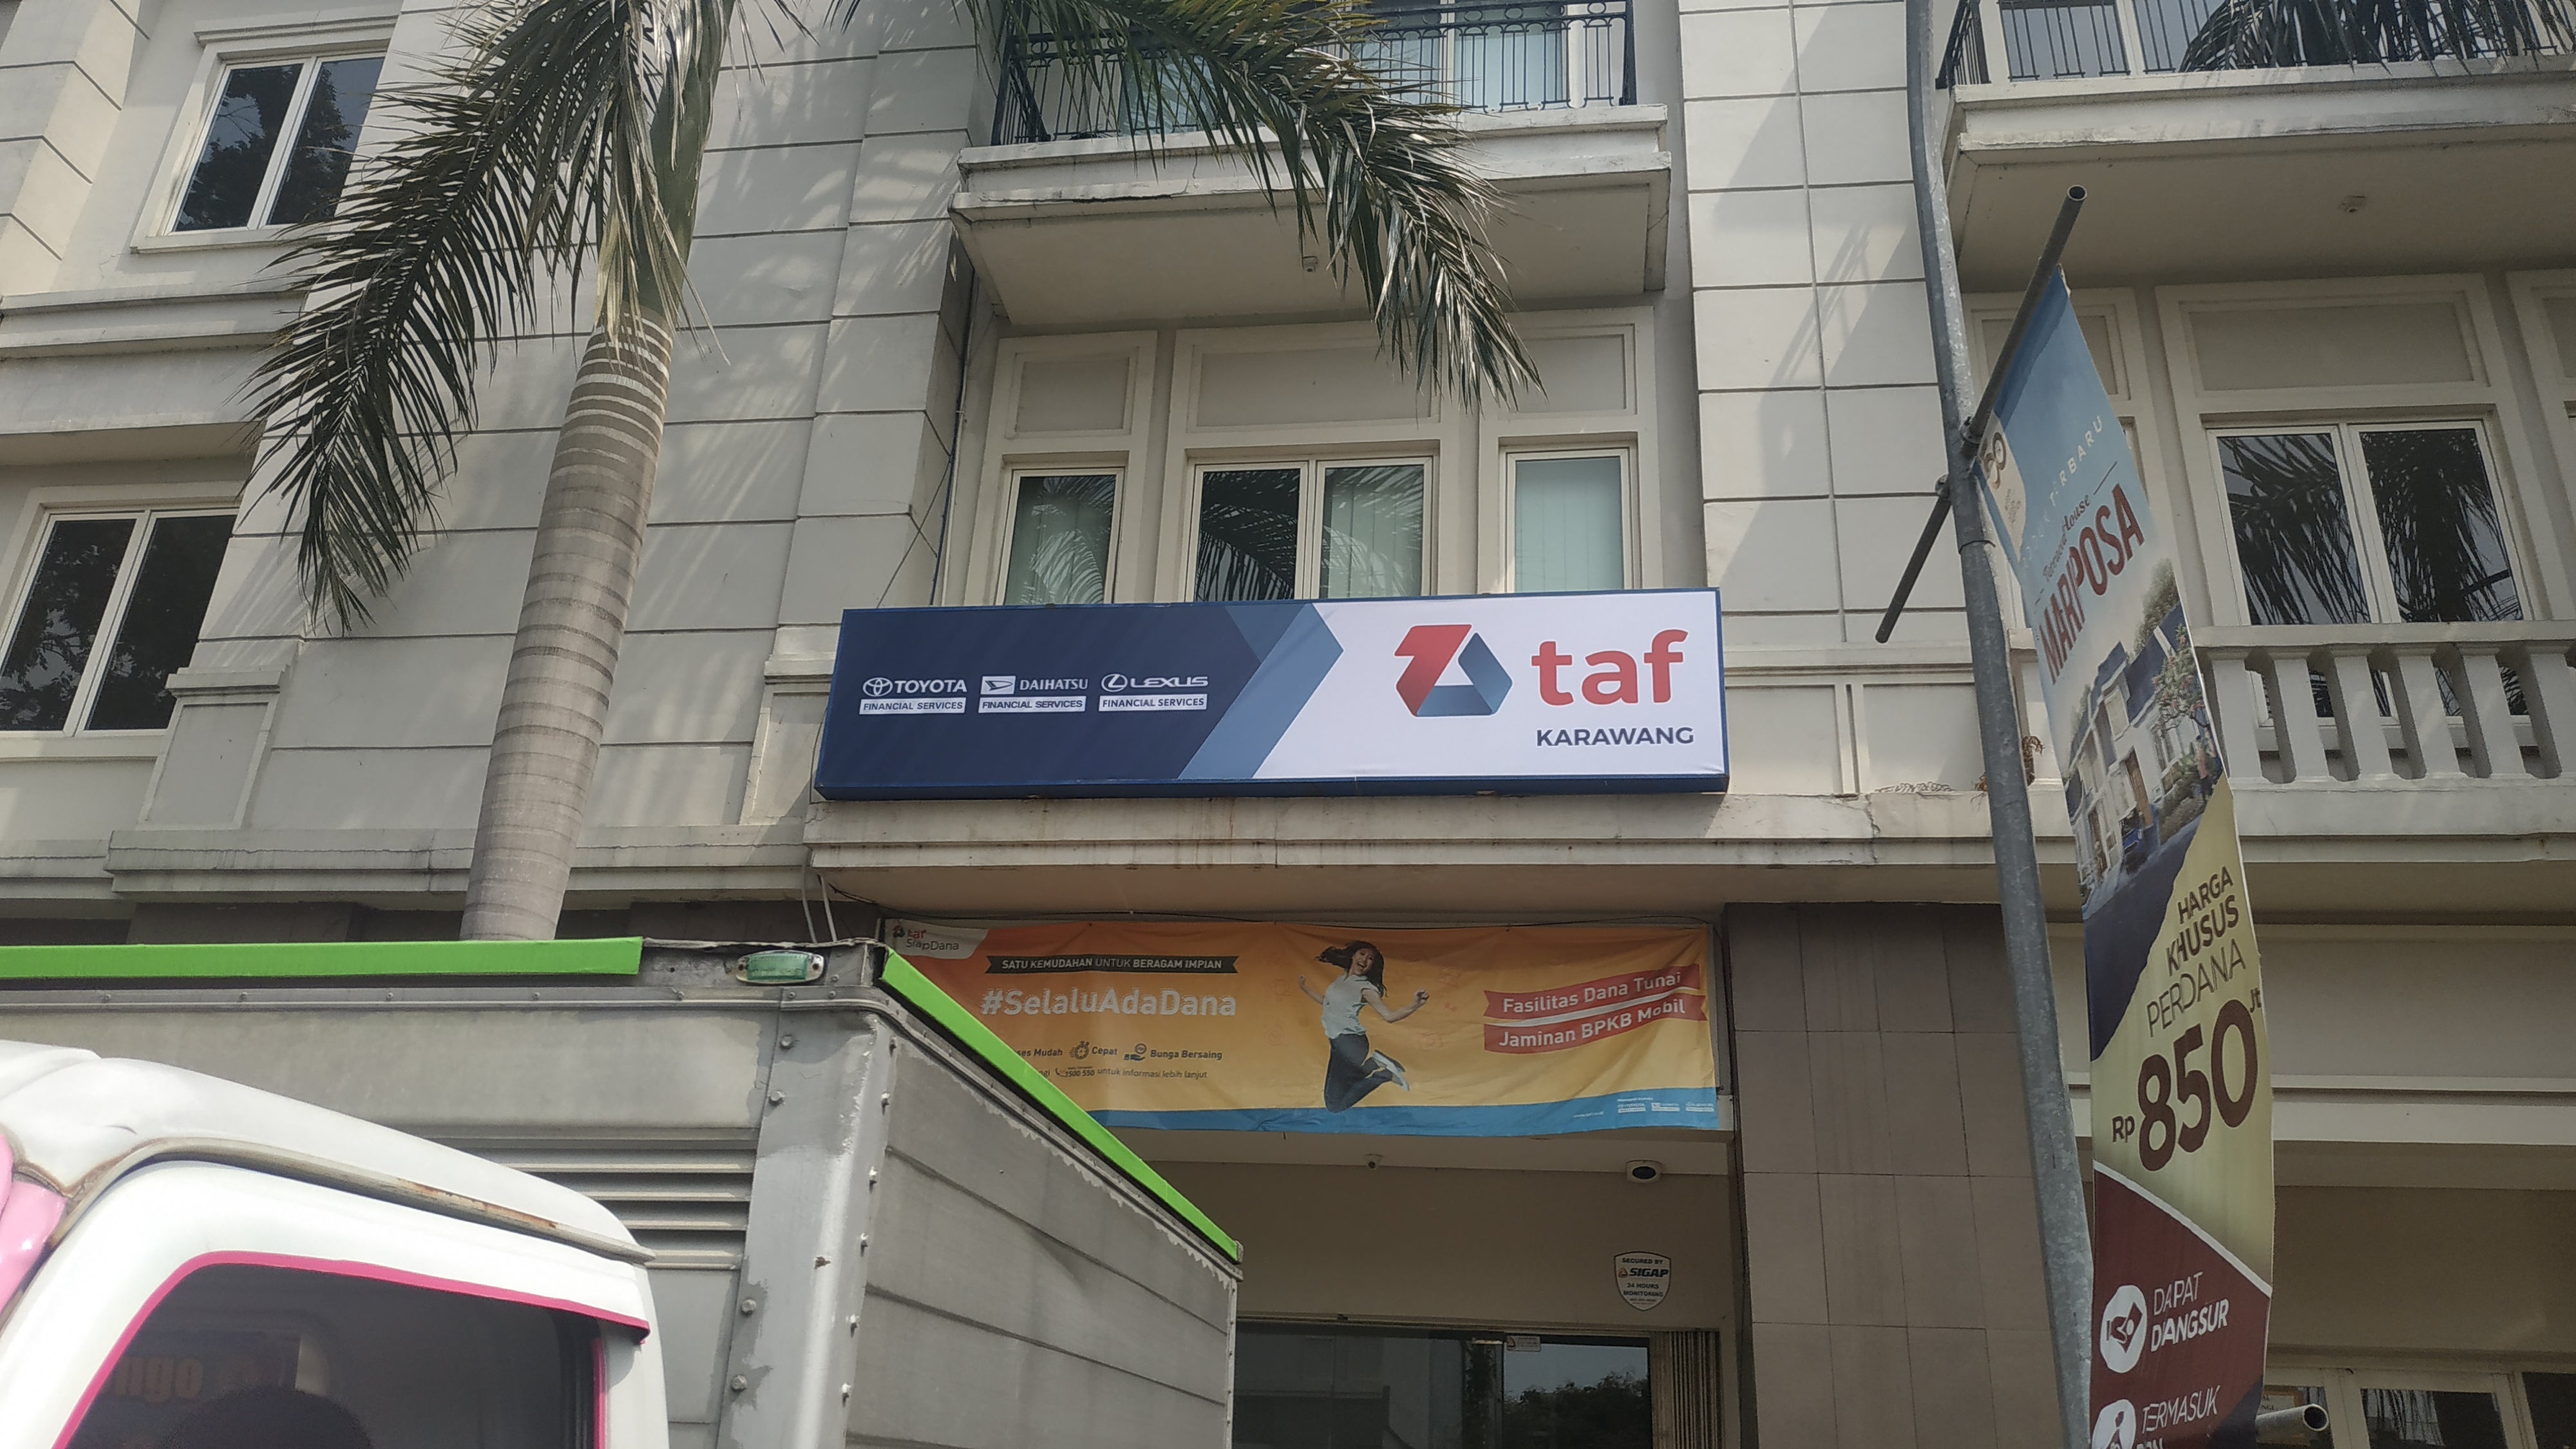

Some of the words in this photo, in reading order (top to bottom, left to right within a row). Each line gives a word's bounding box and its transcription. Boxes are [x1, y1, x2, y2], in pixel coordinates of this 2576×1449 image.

[2039, 484, 2145, 685] MARIPOSA
[1531, 629, 1689, 706] taf
[895, 679, 967, 694] TOYOTA
[1019, 678, 1088, 690] DAIHATSU
[1130, 676, 1209, 688] LEXUS
[863, 702, 914, 710] FINANCIAL
[917, 701, 963, 710] SERVICES
[982, 701, 1032, 709] FINANCIAL
[1102, 699, 1155, 708] FINANCIAL
[1158, 698, 1204, 706] SERVICES
[1536, 726, 1694, 746] KARAWANG
[2177, 866, 2233, 923] HARGA
[907, 929, 927, 939] taf
[2165, 895, 2239, 976] KHUSUS
[905, 938, 960, 951] SiapDana
[1001, 960, 1028, 969] SATU
[1030, 958, 1093, 969] KEMUDAHAN
[1095, 958, 1131, 967] UNTUK
[1133, 959, 1183, 969] BERAGAM
[1185, 960, 1222, 969] IMPIAN
[1503, 994, 1578, 1013] Fasilitas
[1584, 983, 1629, 1003] Dana
[1633, 972, 1681, 992] Tunai
[2146, 938, 2246, 1037] PERDANA
[980, 988, 1237, 1016] #SelaluAdaDana
[1499, 1030, 1576, 1047] Jaminan
[1581, 1012, 1632, 1039] BPKB
[1637, 999, 1686, 1023] Mobil
[1034, 1048, 1063, 1057] Mudah
[1092, 1046, 1118, 1056] Cepat
[1150, 1050, 1179, 1060] Bunga
[1181, 1050, 1223, 1061] Bersaing
[1097, 1068, 1121, 1077] untuk
[2112, 1115, 2136, 1143] Rp
[2137, 999, 2258, 1171] 850
[1629, 1267, 1669, 1278] SIGAP
[2154, 1271, 2203, 1316] DAPAT
[2141, 1385, 2221, 1434] TERMASUK
